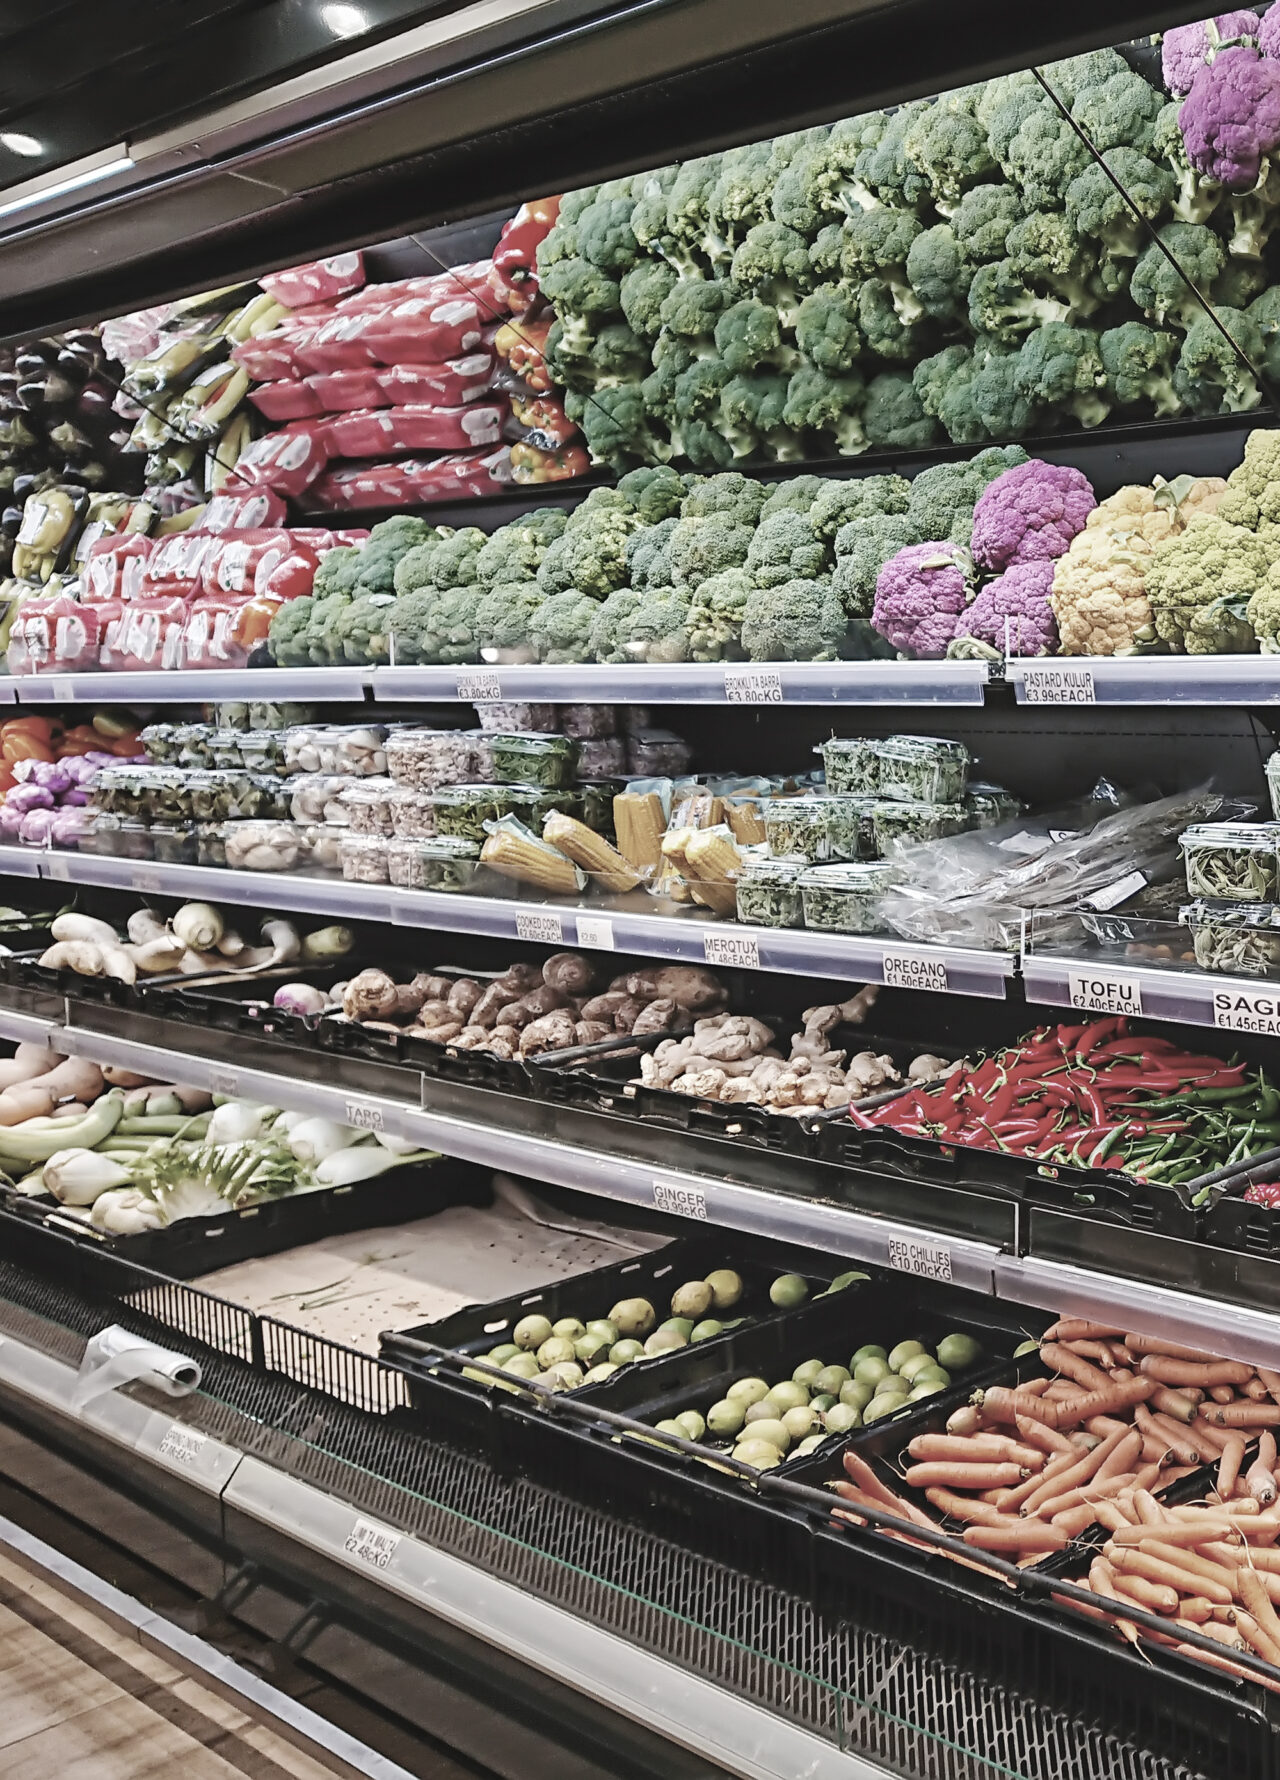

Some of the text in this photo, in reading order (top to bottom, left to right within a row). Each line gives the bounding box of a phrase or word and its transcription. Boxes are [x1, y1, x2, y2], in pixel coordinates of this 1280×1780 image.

[1023, 672, 1092, 687] PASTARD KULUR
[1026, 689, 1093, 702] €3.99cEACH
[542, 918, 560, 931] CORN
[705, 938, 757, 954] MERQTUX
[884, 957, 946, 977] OREGANO
[1077, 978, 1132, 1000] TOFU
[1073, 995, 1141, 1015] €2.40cEACH
[654, 1186, 706, 1207] GINGER
[889, 1240, 950, 1267] RED CHILLIES
[890, 1255, 952, 1280] €10.00cKG
